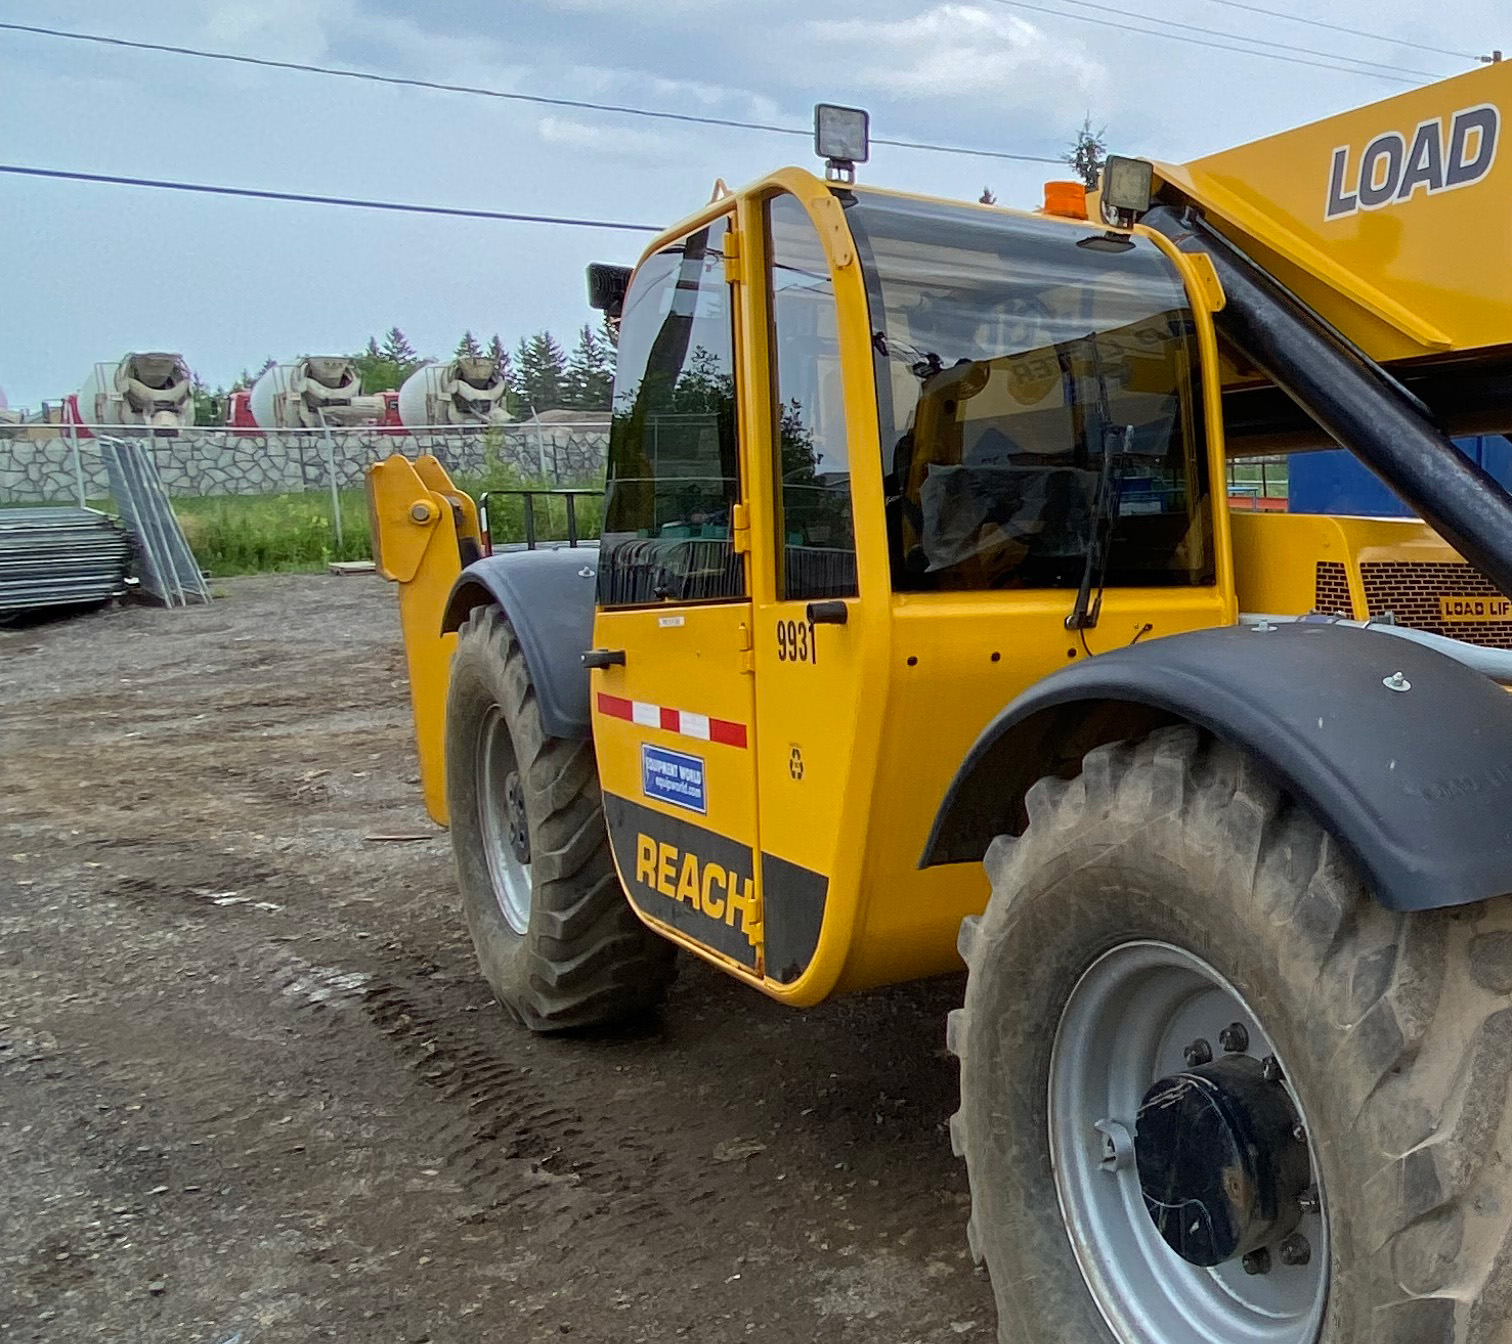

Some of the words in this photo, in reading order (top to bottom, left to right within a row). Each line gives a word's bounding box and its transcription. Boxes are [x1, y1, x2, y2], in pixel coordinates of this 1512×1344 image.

[1325, 103, 1500, 221] LOAD
[777, 620, 817, 665] 9931
[1445, 602, 1485, 615] LOAD
[636, 832, 754, 935] REACH
